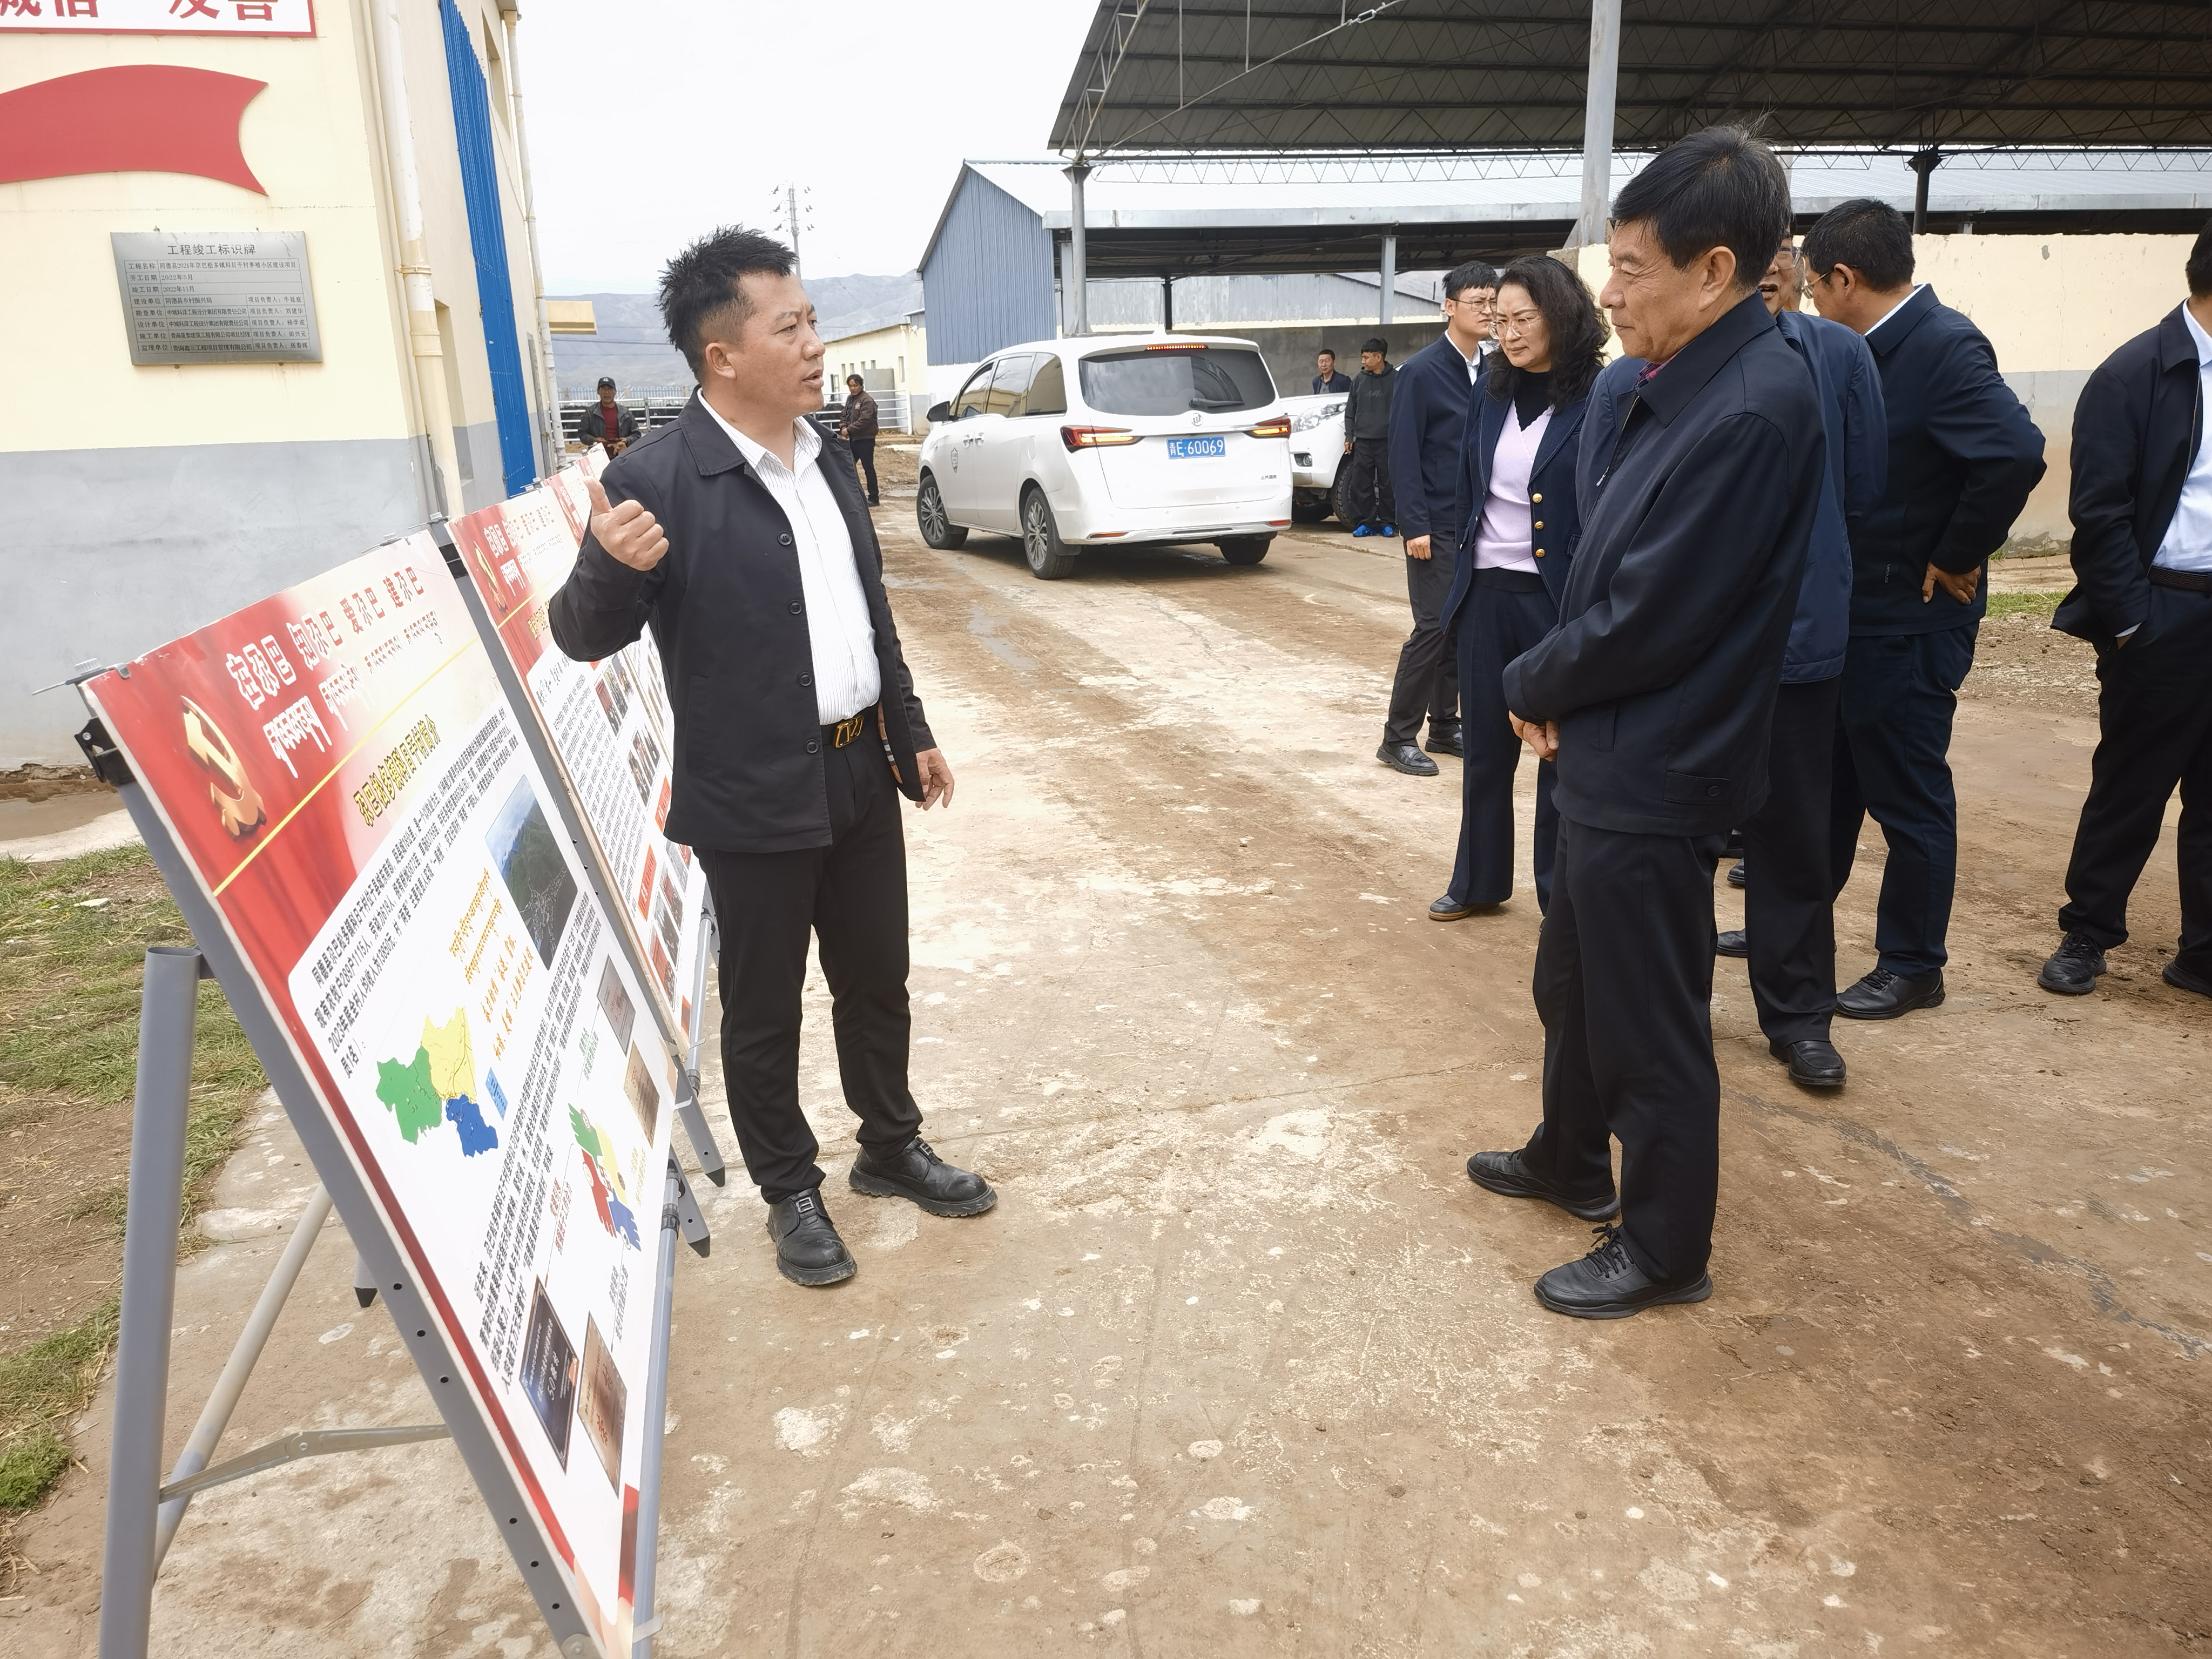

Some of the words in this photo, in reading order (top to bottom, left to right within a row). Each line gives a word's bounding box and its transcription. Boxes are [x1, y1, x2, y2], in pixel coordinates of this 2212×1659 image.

[167, 243, 257, 256] 工程竣工标识牌
[172, 343, 252, 352] 青海鑫工程项目管理有限公司
[222, 631, 300, 714] 在尕巴
[285, 603, 347, 672] 知尕巴
[338, 584, 386, 636] 爱尕巴
[381, 563, 424, 610] 建尕巴
[351, 711, 442, 831] 尕巴松多镇科日干村简介
